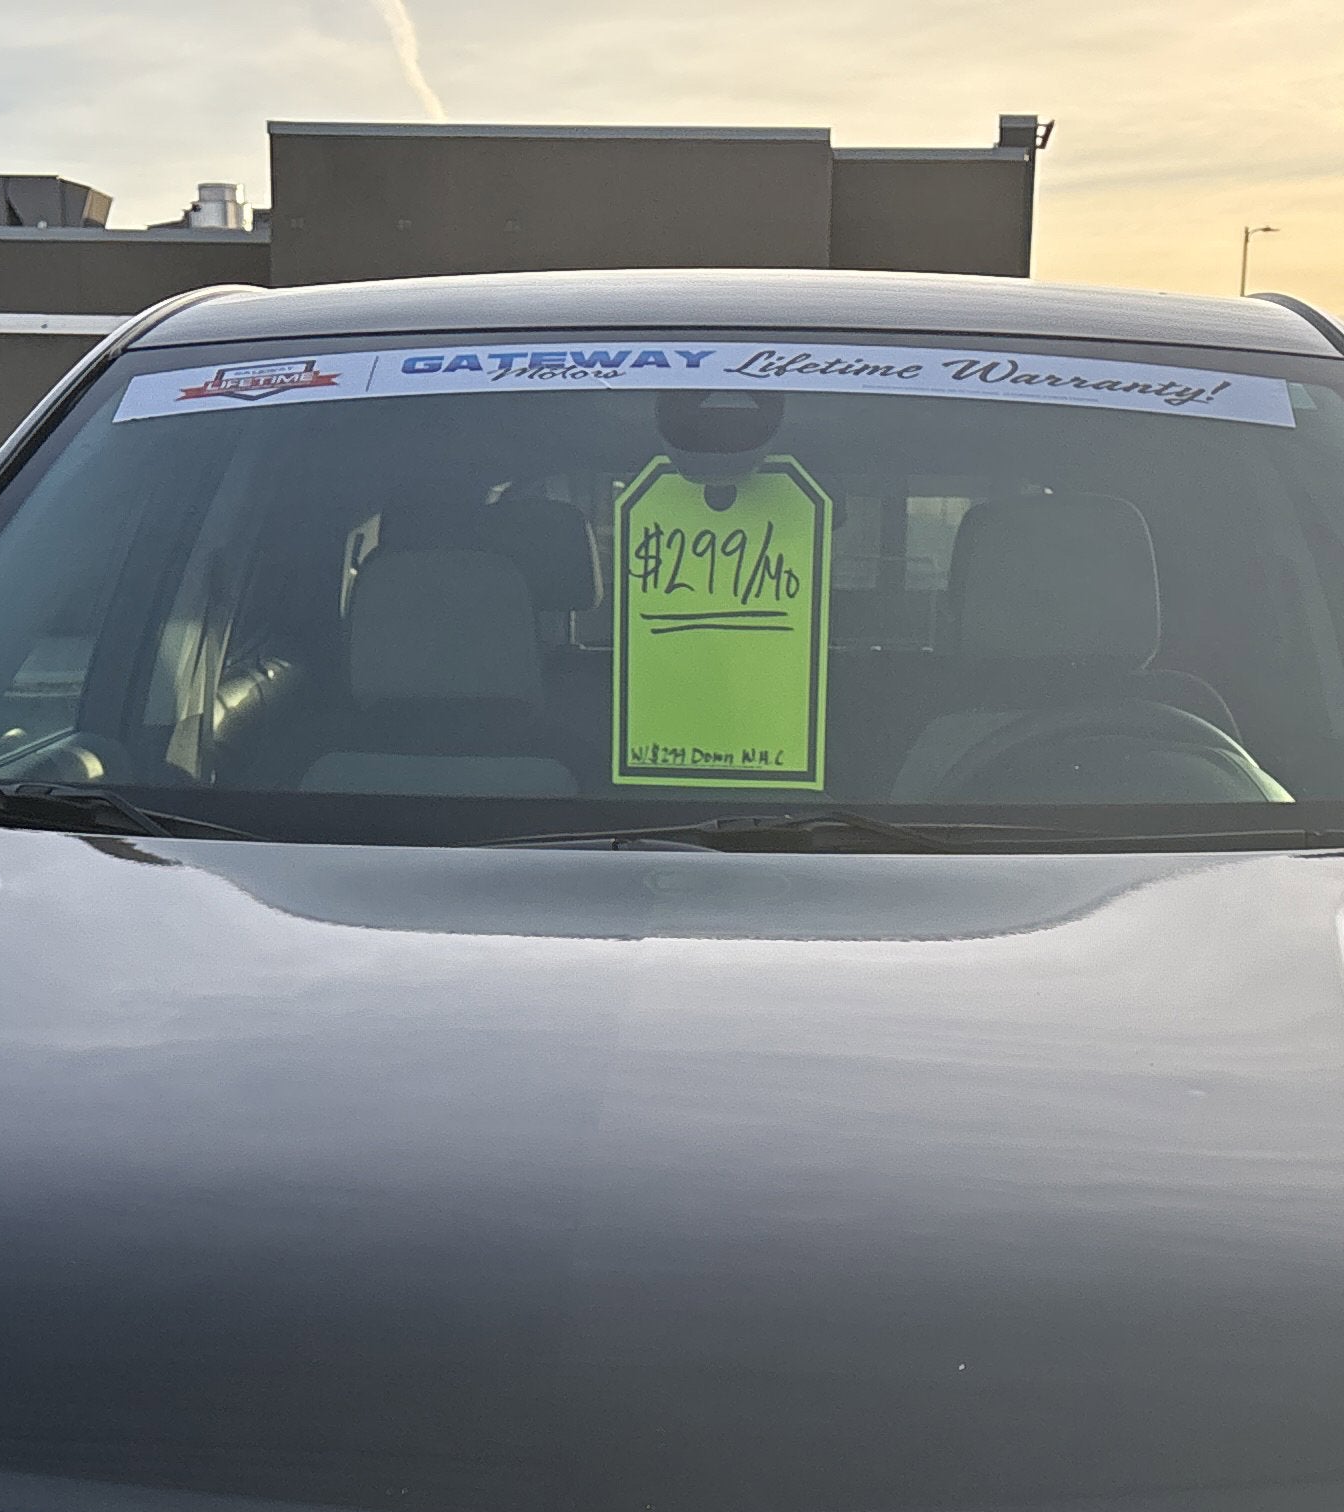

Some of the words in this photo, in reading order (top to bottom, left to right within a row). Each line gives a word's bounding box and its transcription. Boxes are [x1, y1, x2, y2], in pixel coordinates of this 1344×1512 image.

[401, 350, 717, 374] GATEWAY
[207, 371, 314, 391] LIFETIME
[487, 365, 626, 382] Motors
[723, 350, 923, 379] Lifetime
[942, 359, 1231, 406] Warranty!
